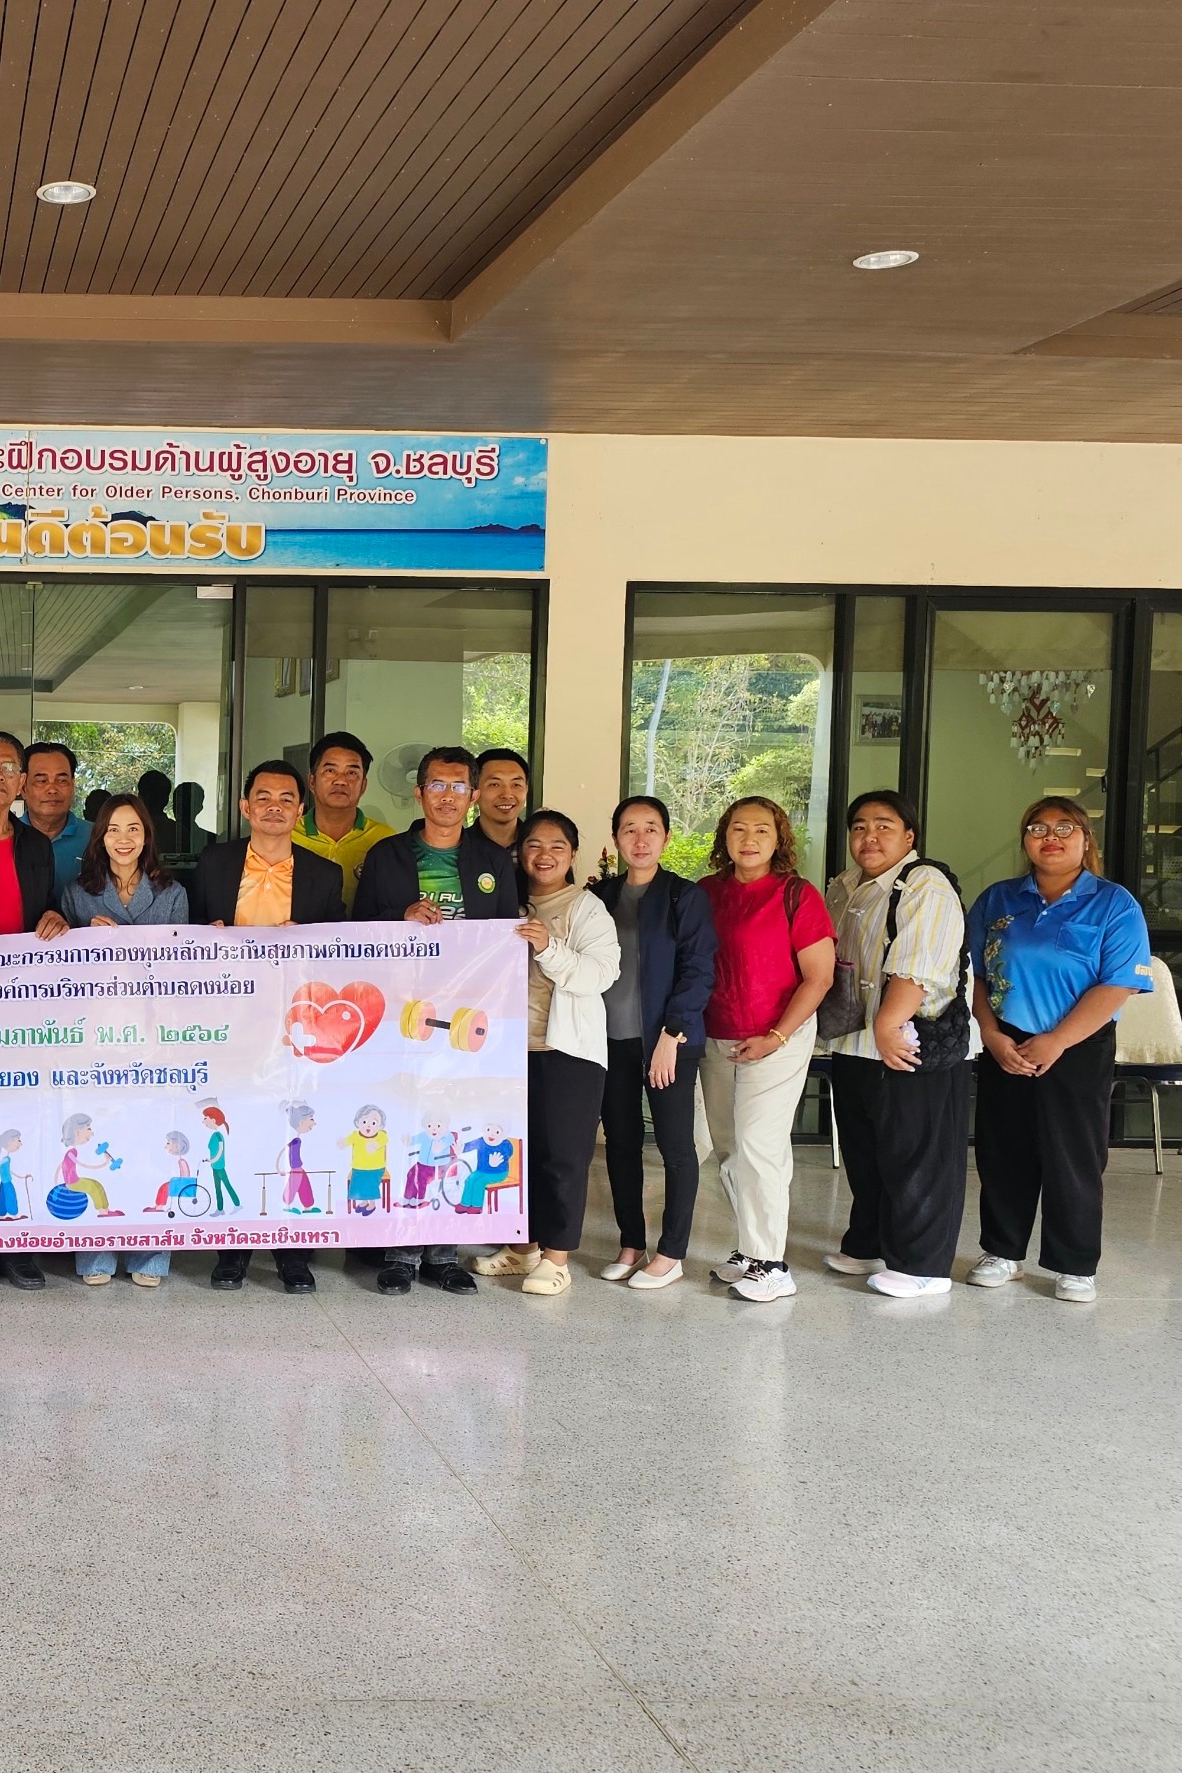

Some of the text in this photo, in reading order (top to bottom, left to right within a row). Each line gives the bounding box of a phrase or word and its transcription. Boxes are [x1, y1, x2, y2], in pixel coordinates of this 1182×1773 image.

[371, 444, 499, 486] จ.ชลบุรี
[1, 483, 64, 499] Center
[71, 484, 97, 499] for
[105, 485, 153, 500] Older
[248, 486, 329, 502] Chonburi
[337, 488, 415, 503] Province
[97, 1024, 145, 1043] พ.ศ.
[52, 1061, 208, 1091] และจังหวัดชลบุรี
[191, 1227, 339, 1245] จังหวัดฉะเชิงเทรา
